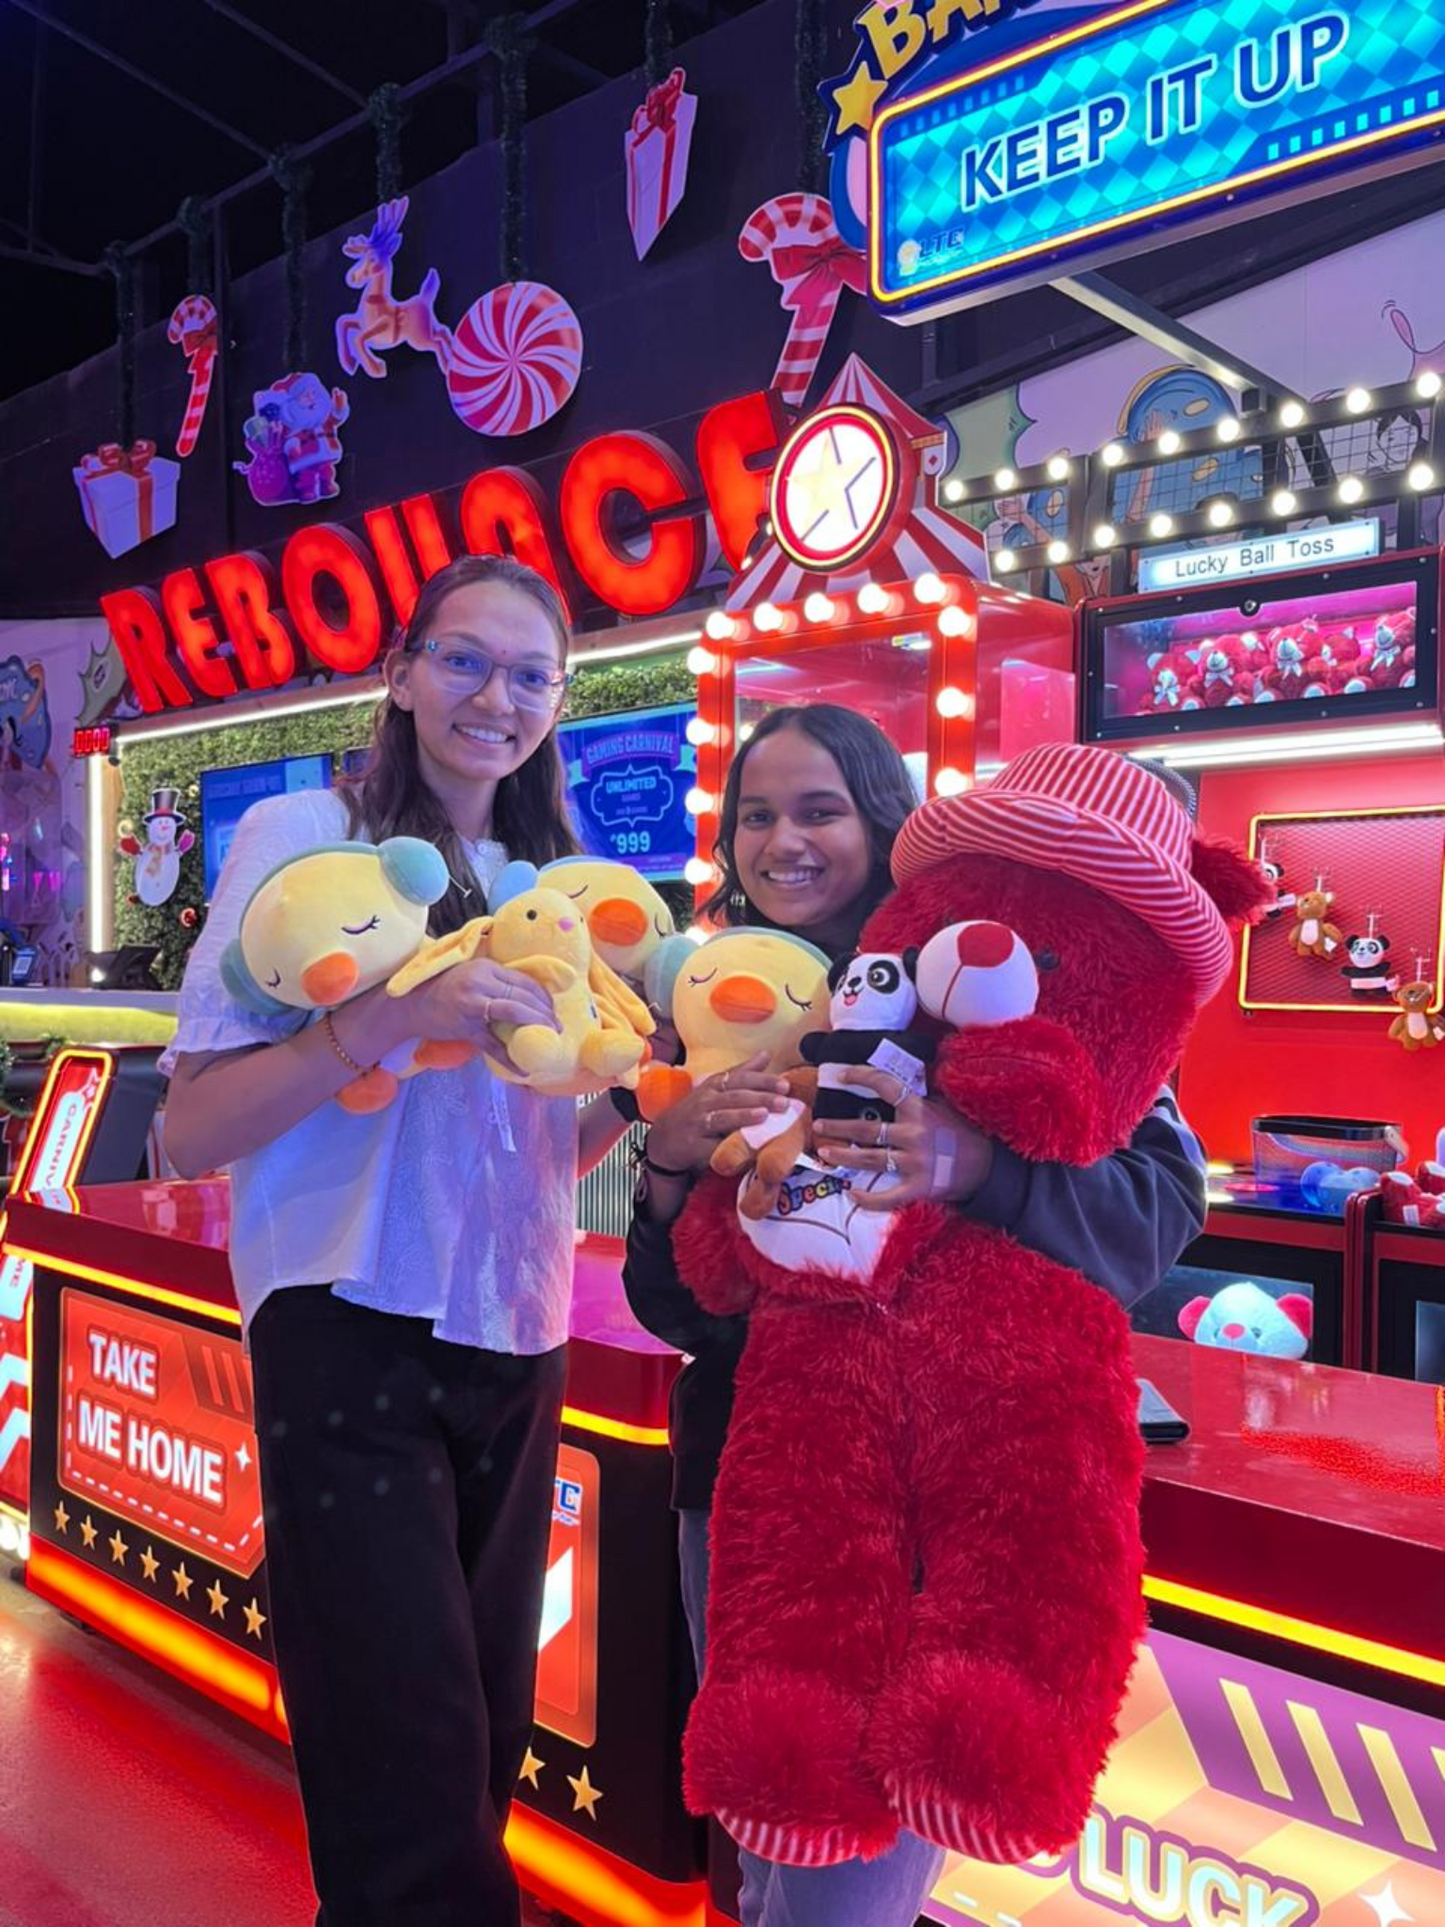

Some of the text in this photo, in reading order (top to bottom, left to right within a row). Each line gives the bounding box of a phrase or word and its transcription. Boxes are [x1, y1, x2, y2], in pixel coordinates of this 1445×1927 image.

[964, 14, 1345, 207] KEEP IT UP
[1175, 537, 1335, 577] Lucky Ball Toss
[625, 733, 674, 754] CARNIVAL
[606, 776, 657, 794] UNLIMITED
[88, 1332, 157, 1396] TAKE
[78, 1398, 223, 1504] ME HOME
[1079, 1811, 1309, 1927] LUCK
